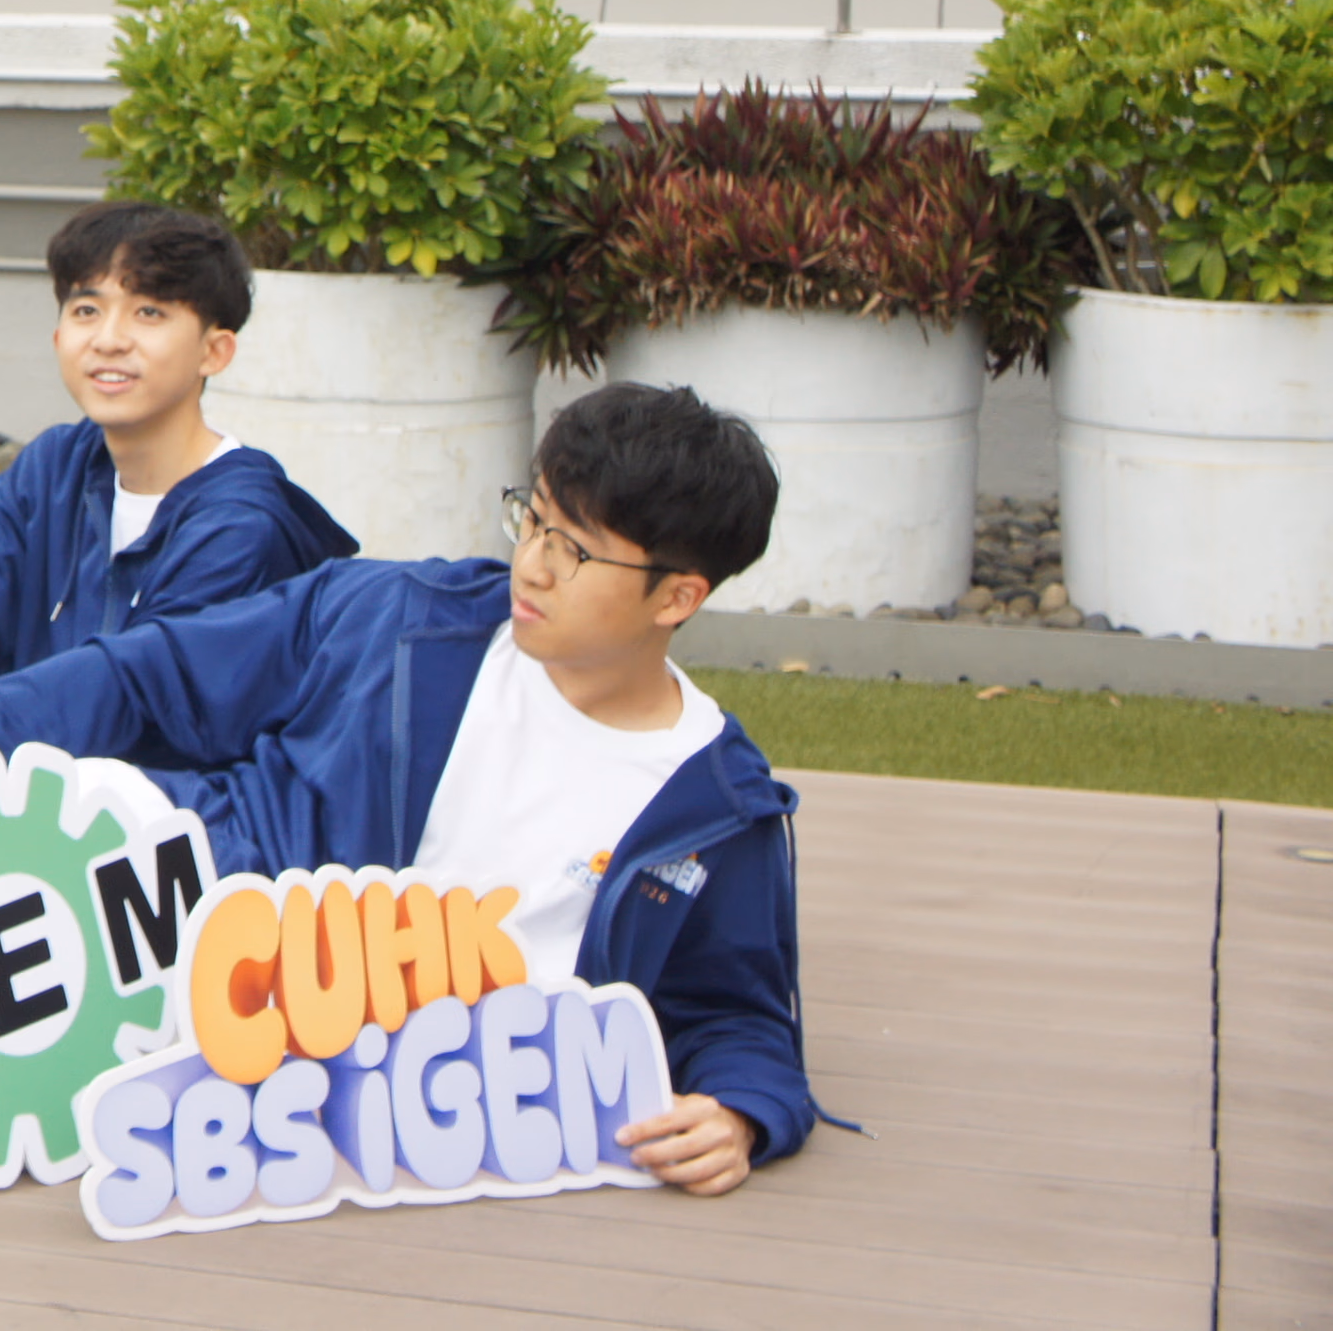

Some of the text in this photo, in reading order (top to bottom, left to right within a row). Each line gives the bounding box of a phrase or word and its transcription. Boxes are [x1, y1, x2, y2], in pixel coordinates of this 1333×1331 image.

[191, 880, 527, 1084] CUHK
[95, 985, 662, 1227] SBS iGEM
